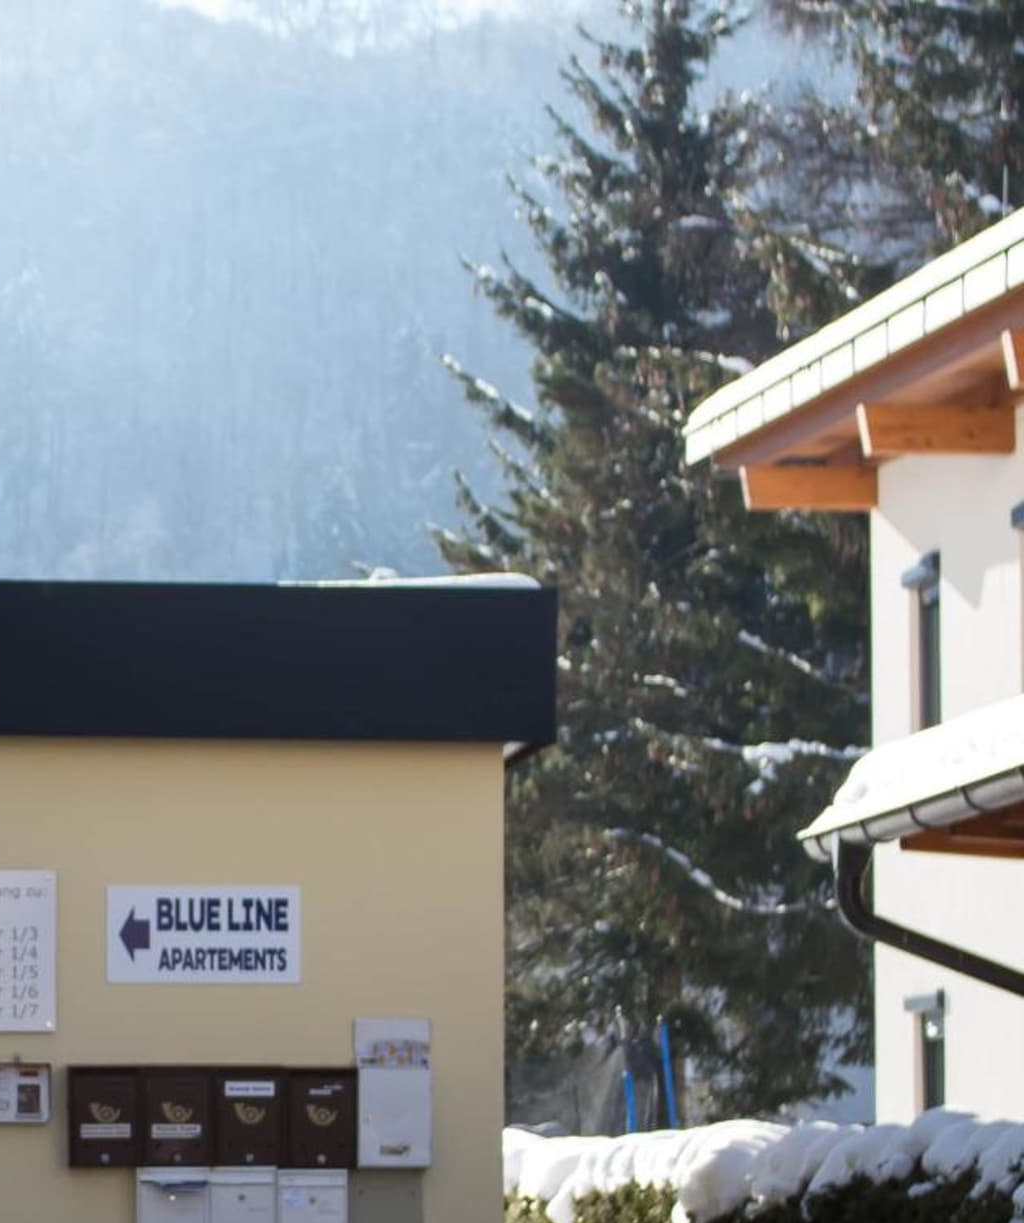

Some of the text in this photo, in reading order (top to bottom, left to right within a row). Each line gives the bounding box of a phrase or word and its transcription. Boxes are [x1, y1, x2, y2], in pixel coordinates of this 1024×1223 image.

[156, 898, 289, 932] BLUE LINE
[12, 925, 38, 943] 1/3
[12, 945, 38, 962] 1/4
[158, 948, 287, 972] APARTEMENTS
[12, 965, 39, 981] 1/5
[11, 984, 39, 1001] 1/6
[12, 1003, 39, 1019] 1/7
